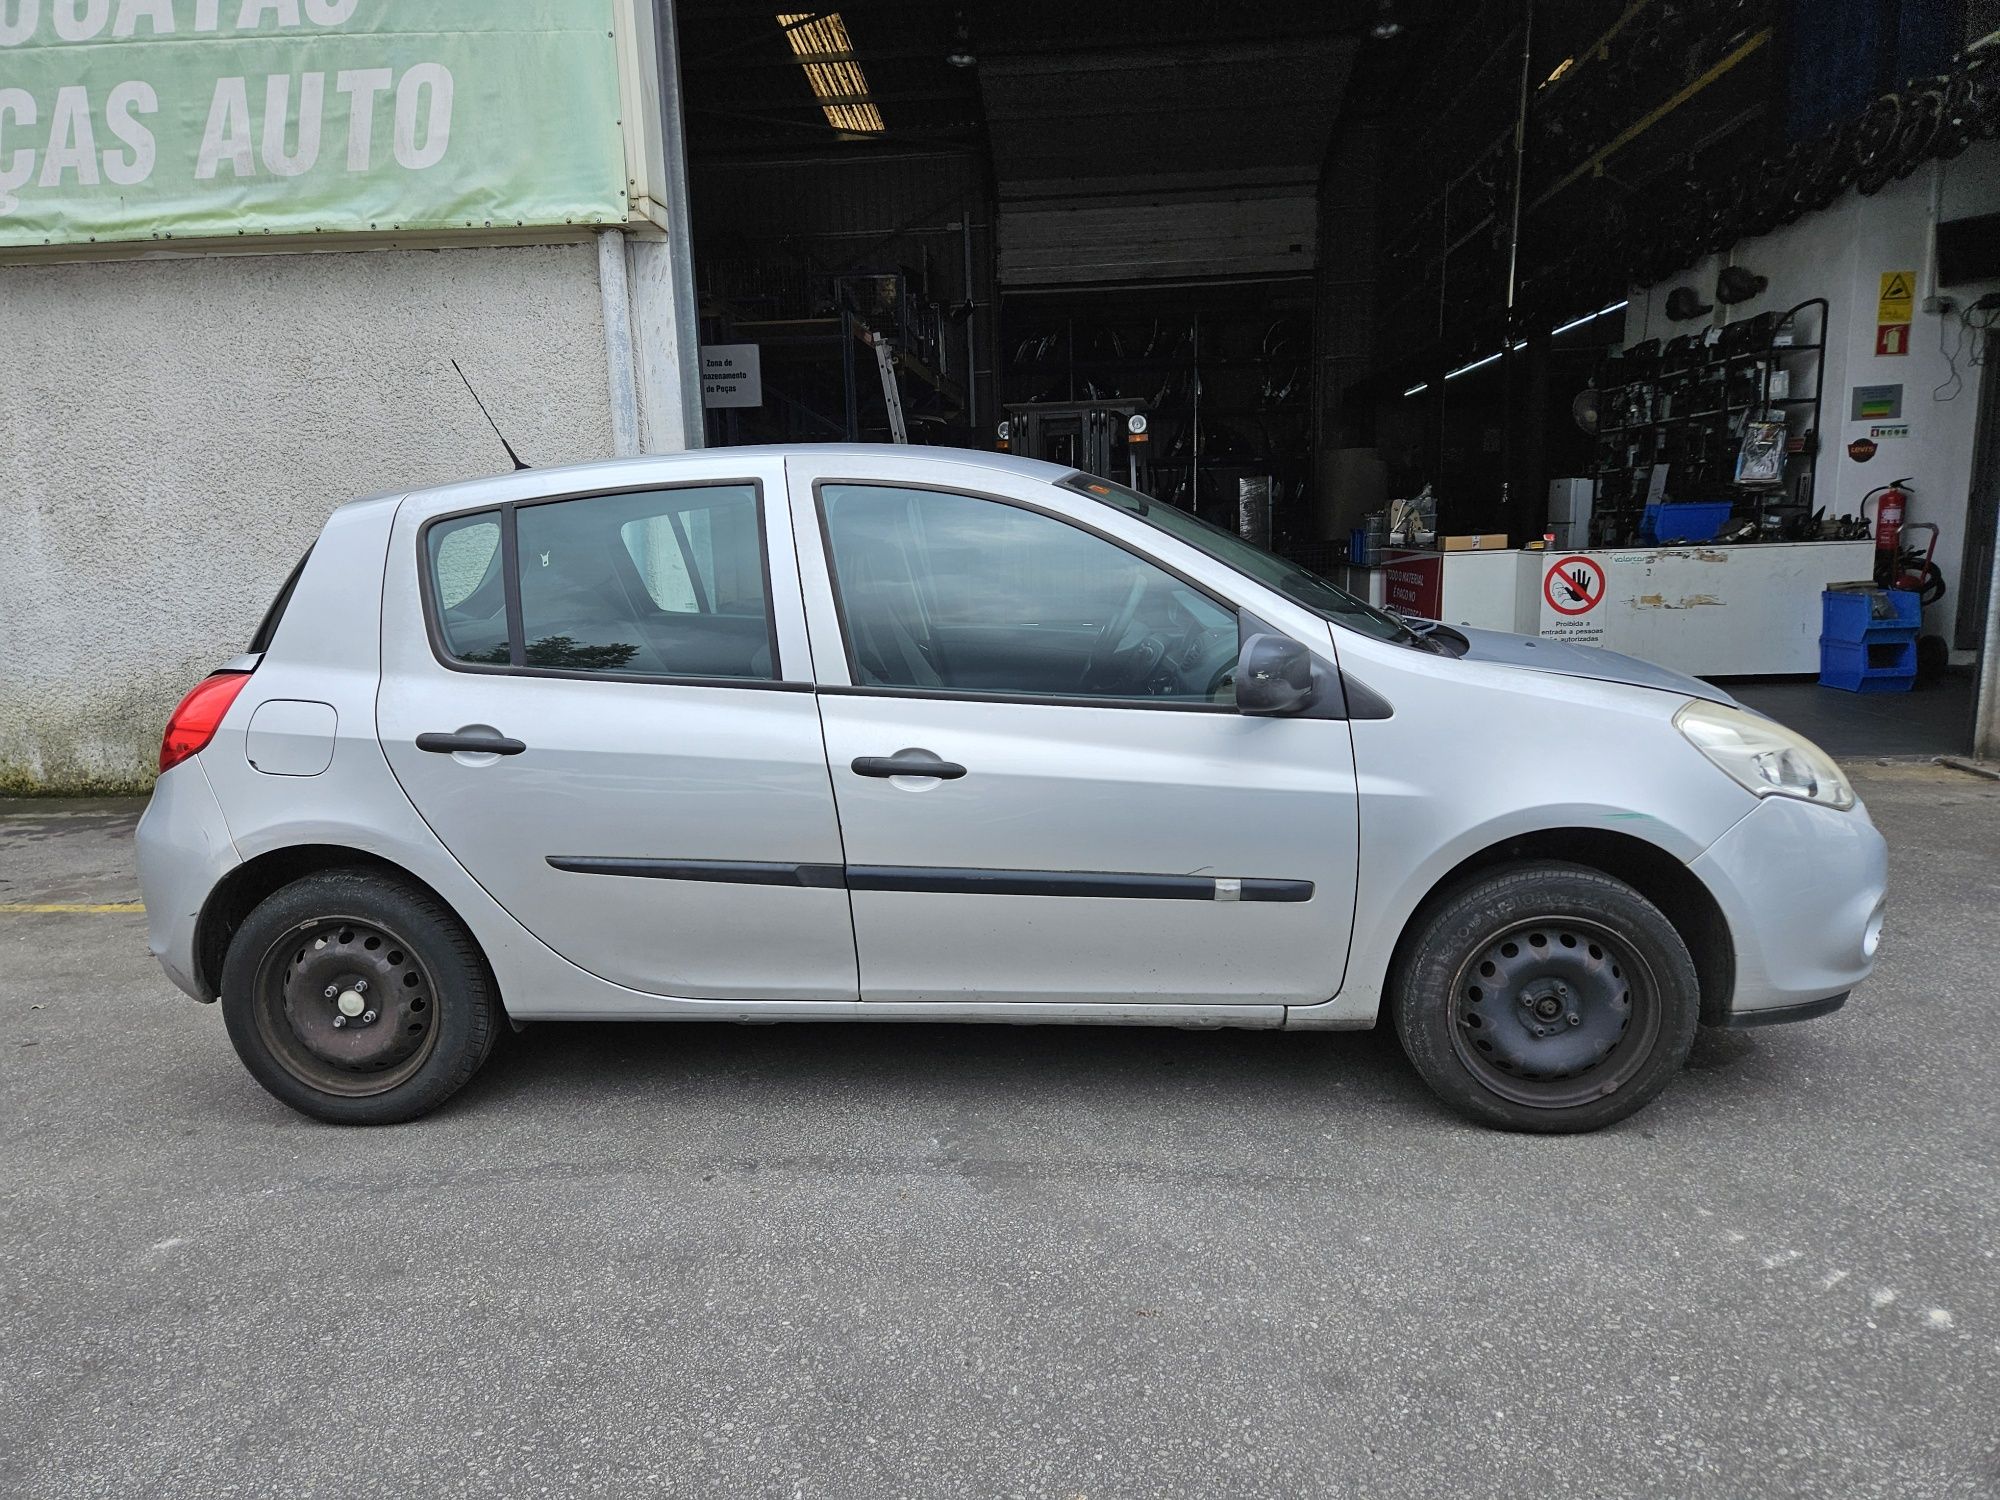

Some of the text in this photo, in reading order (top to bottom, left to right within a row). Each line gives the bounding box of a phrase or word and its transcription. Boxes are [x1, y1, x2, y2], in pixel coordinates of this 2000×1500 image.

[0, 62, 454, 214] ÇAS AUTO
[706, 359, 722, 367] Zona
